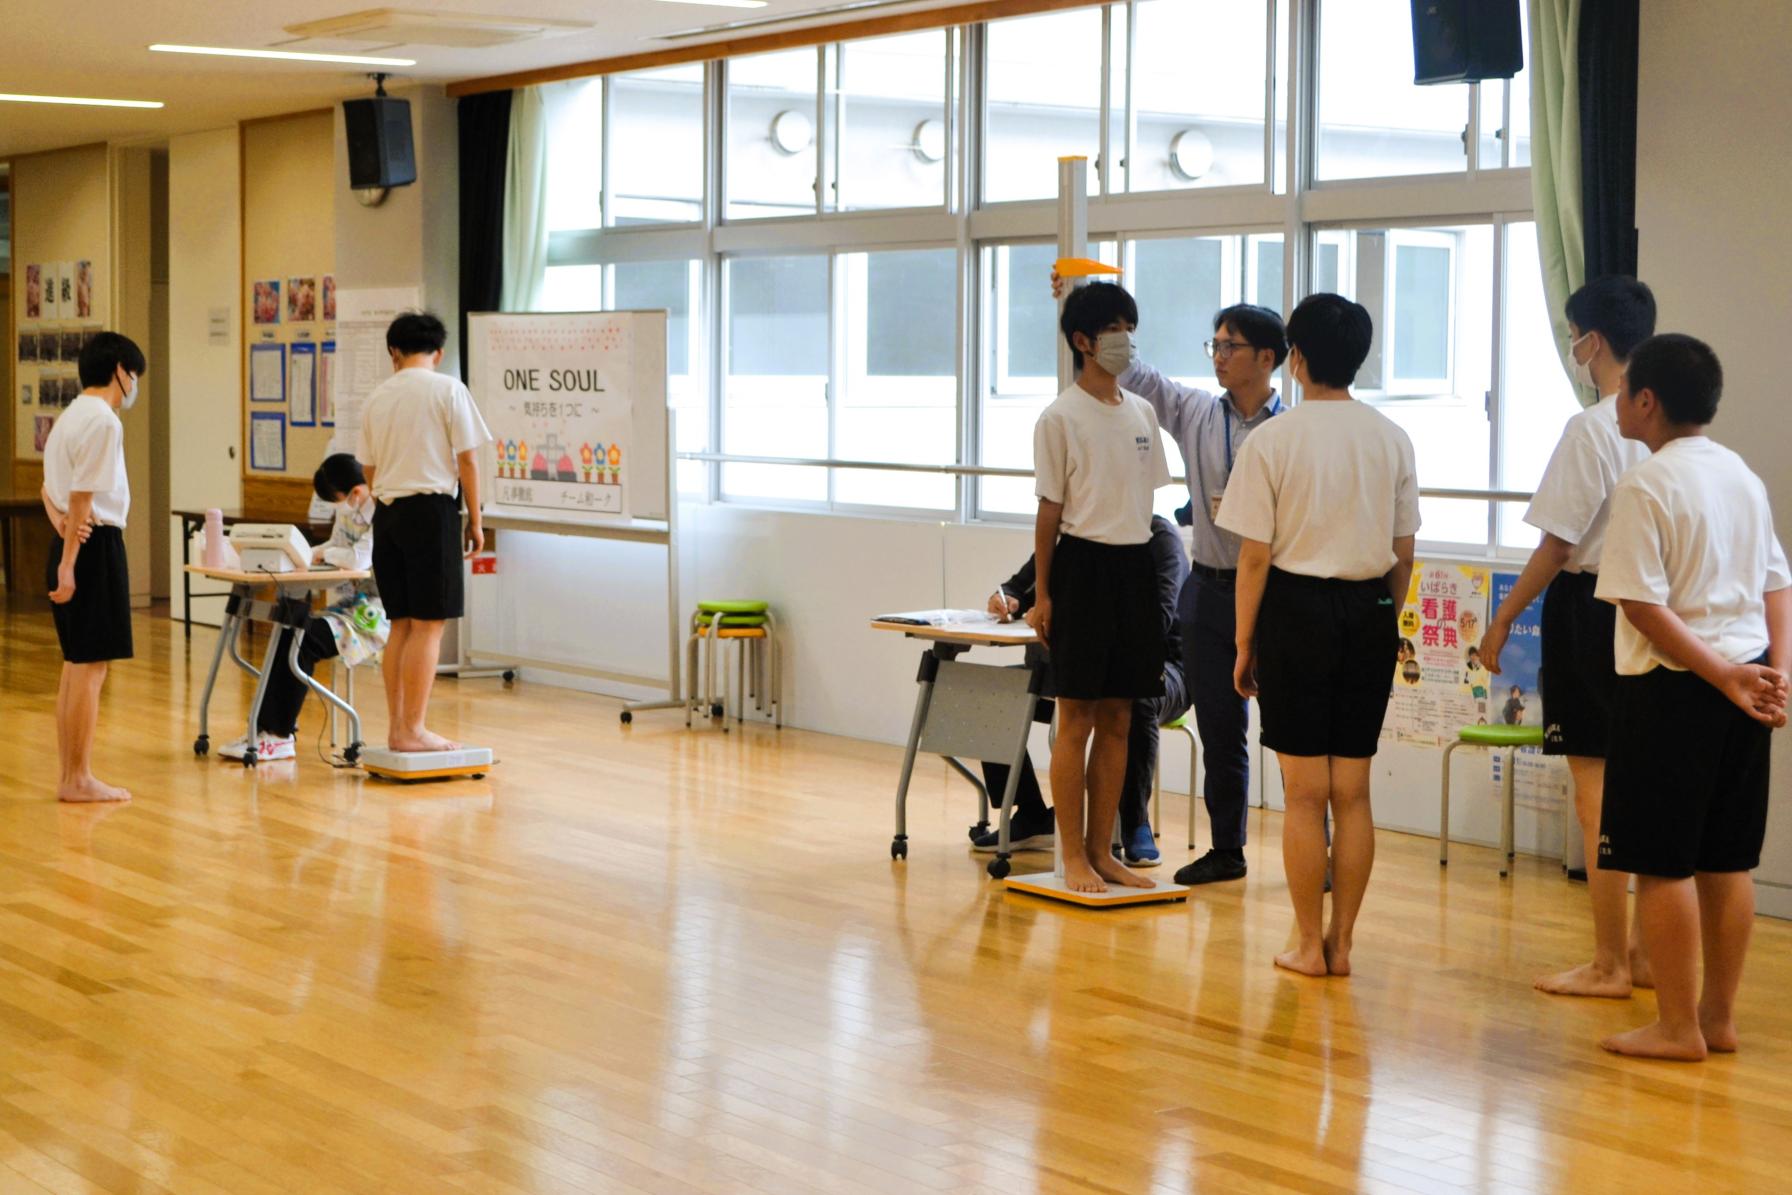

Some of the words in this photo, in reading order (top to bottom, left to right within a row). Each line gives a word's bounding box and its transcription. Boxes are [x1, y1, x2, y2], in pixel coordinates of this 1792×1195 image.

[503, 368, 540, 391] ONE
[549, 368, 606, 393] SOUL
[1421, 581, 1457, 595] いばらき
[1422, 597, 1457, 622] 看護
[1422, 625, 1458, 649] 祭典
